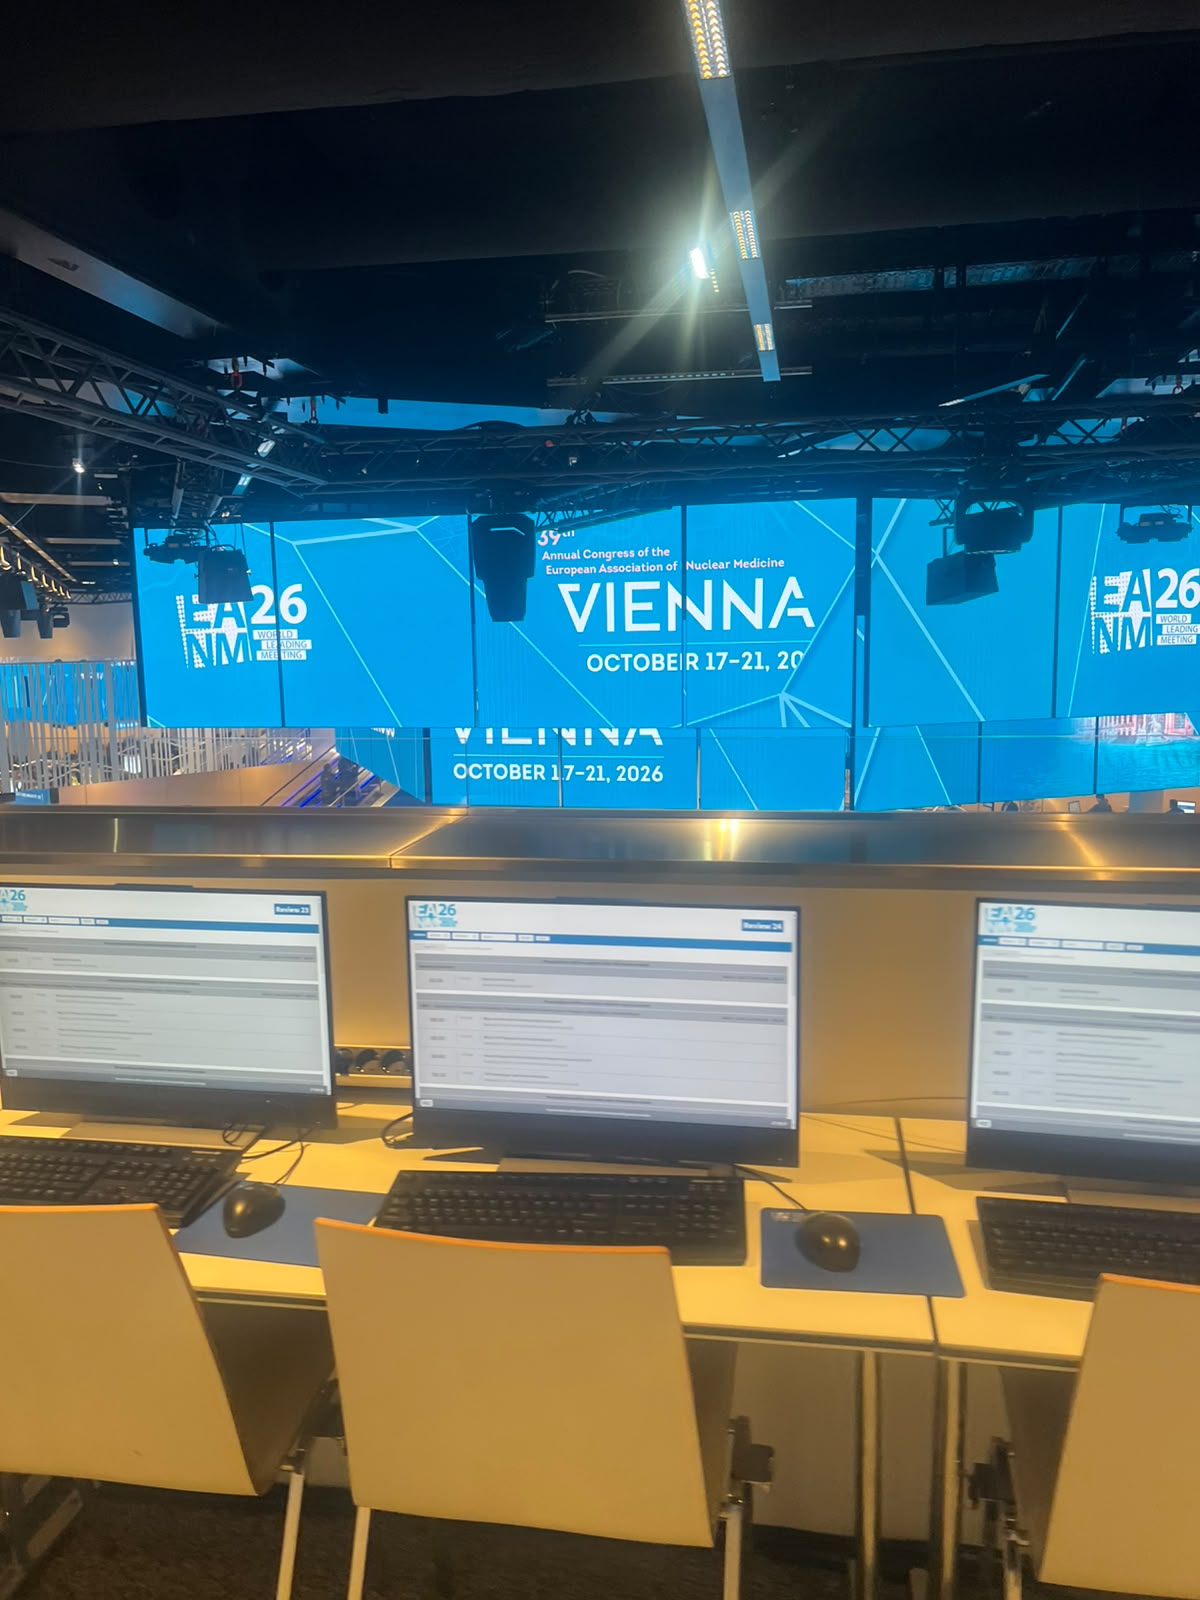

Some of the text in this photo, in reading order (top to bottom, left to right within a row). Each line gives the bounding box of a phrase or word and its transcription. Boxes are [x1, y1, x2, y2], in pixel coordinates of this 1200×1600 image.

[542, 546, 670, 562] Annual Congress of the
[545, 557, 785, 577] European Association of Nuclear Medicine
[557, 576, 816, 633] VIENNA
[1160, 614, 1188, 623] WORLD
[1166, 625, 1199, 634] LEADING
[1160, 635, 1194, 644] MEETING
[586, 652, 699, 672] OCTOBER
[453, 763, 546, 780] OCTOBER
[615, 765, 664, 782] 2026
